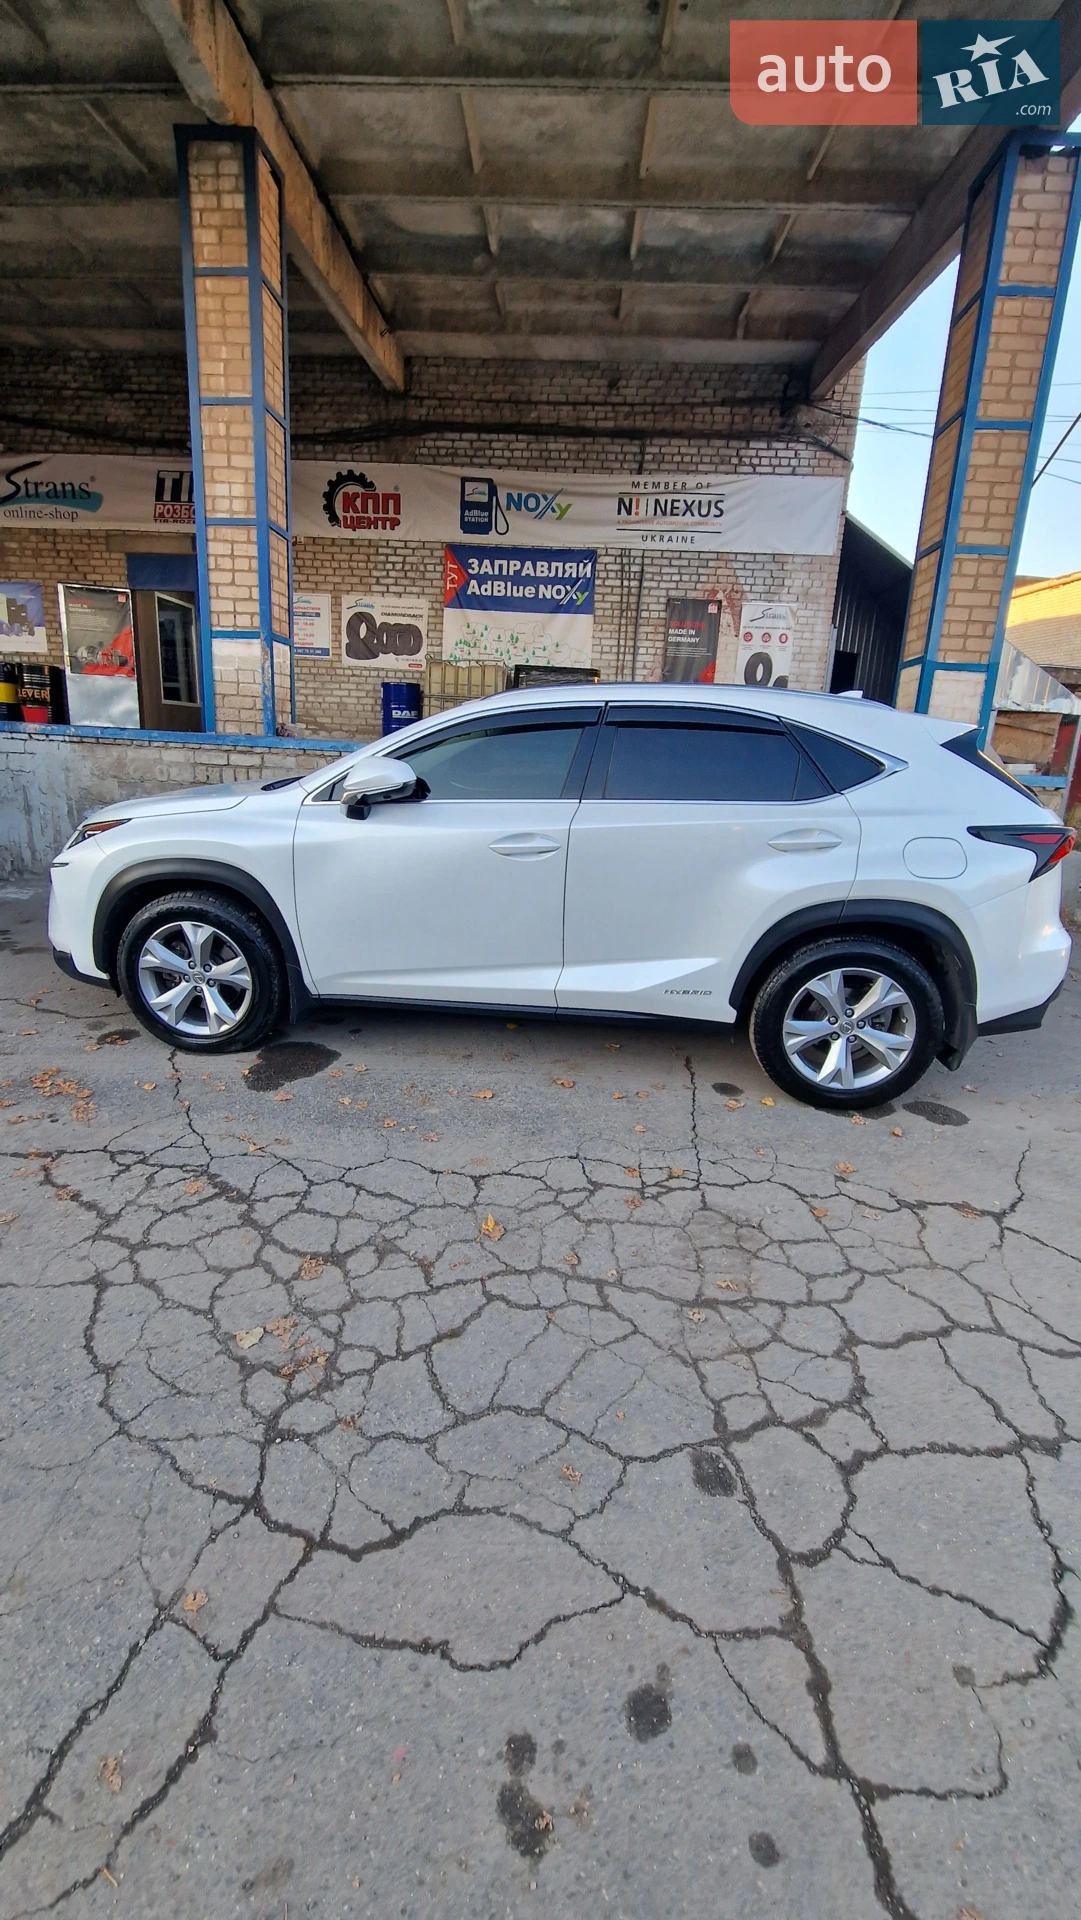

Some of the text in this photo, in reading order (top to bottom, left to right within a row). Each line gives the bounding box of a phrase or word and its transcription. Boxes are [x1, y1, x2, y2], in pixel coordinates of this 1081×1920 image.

[158, 471, 195, 502] TI
[631, 480, 712, 490] MEMBER OF
[342, 491, 401, 516] КПП
[506, 487, 573, 521] NOXy
[653, 498, 725, 518] NEXUS
[3, 506, 79, 523] online-shop
[464, 509, 489, 517] AdBlue
[342, 515, 401, 532] ЦЕНТР
[641, 534, 696, 544] UKRAINE
[446, 560, 459, 591] ТУТ
[467, 557, 593, 579] ЗАПРАВЛЯЙ
[467, 579, 536, 598] AdBlue
[667, 636, 701, 644] GERMANY
[668, 628, 687, 636] MADE
[392, 709, 418, 718] DAF
[663, 988, 713, 996] HYBRID
